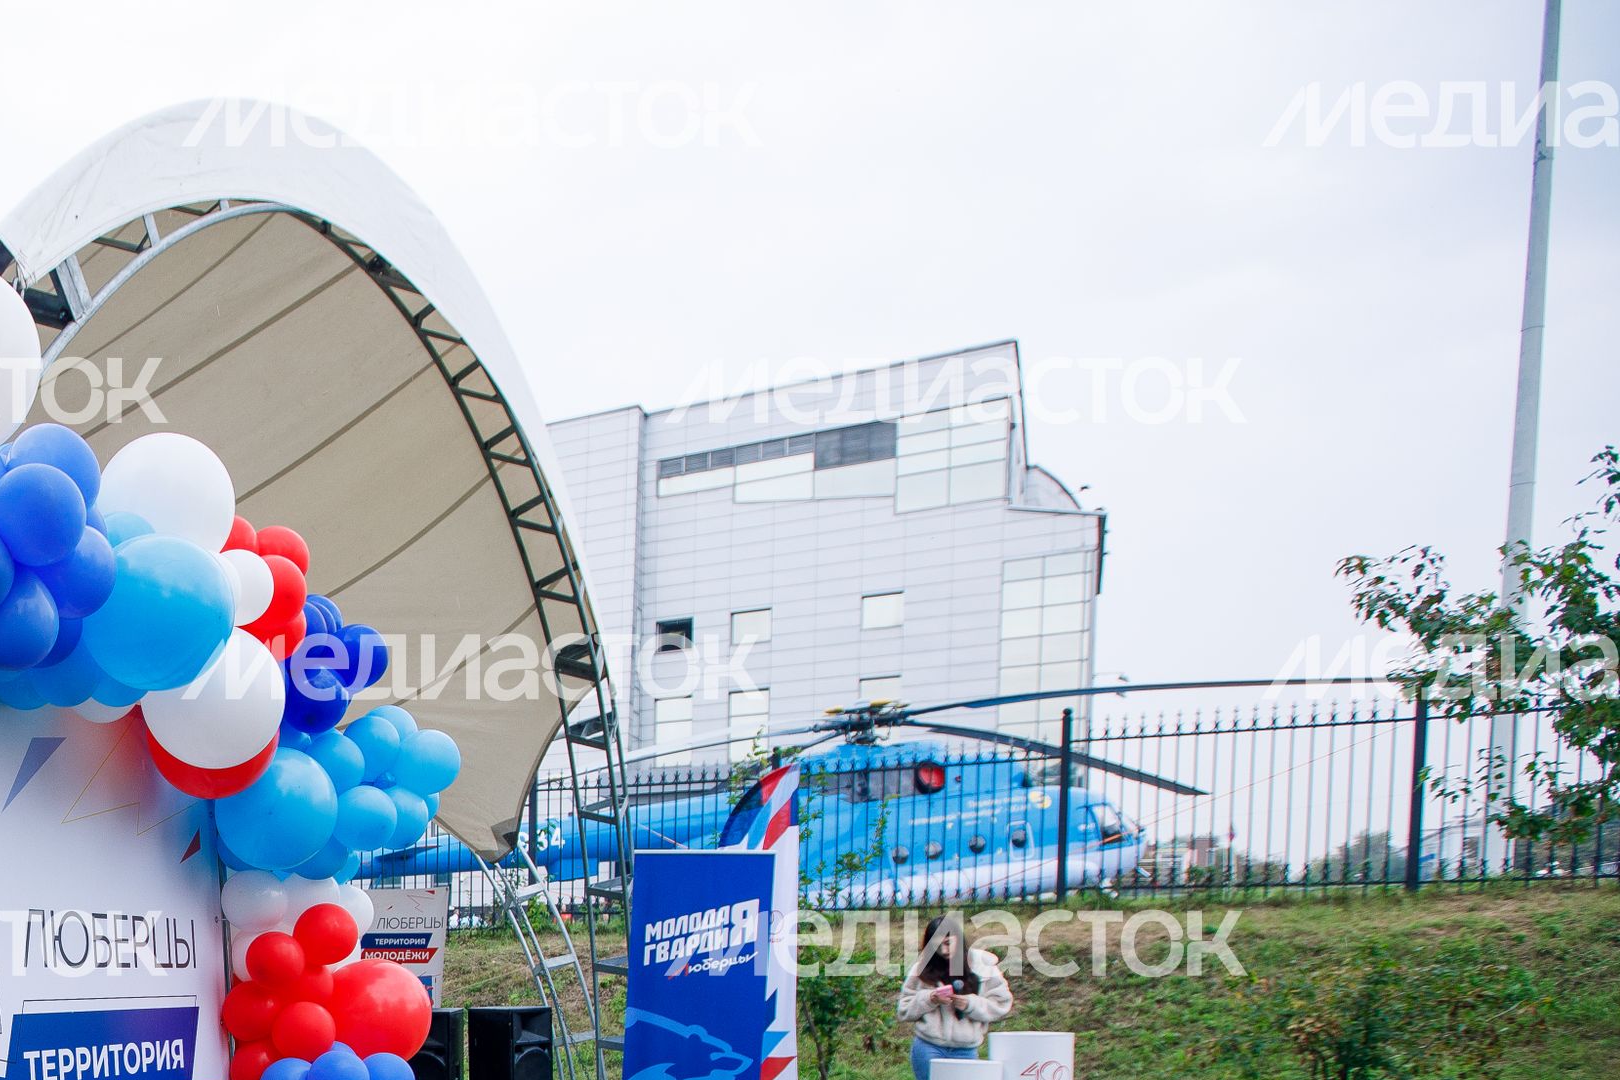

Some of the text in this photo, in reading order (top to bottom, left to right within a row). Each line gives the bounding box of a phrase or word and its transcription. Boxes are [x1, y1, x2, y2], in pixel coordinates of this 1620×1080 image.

[376, 916, 444, 930] ЛЮБЕРЦЫ
[24, 908, 197, 969] ЛЮБЕРЦЫ
[374, 937, 426, 946] ТЕРРИТОРИЯ
[364, 949, 430, 961] МОЛОДЁЖИ
